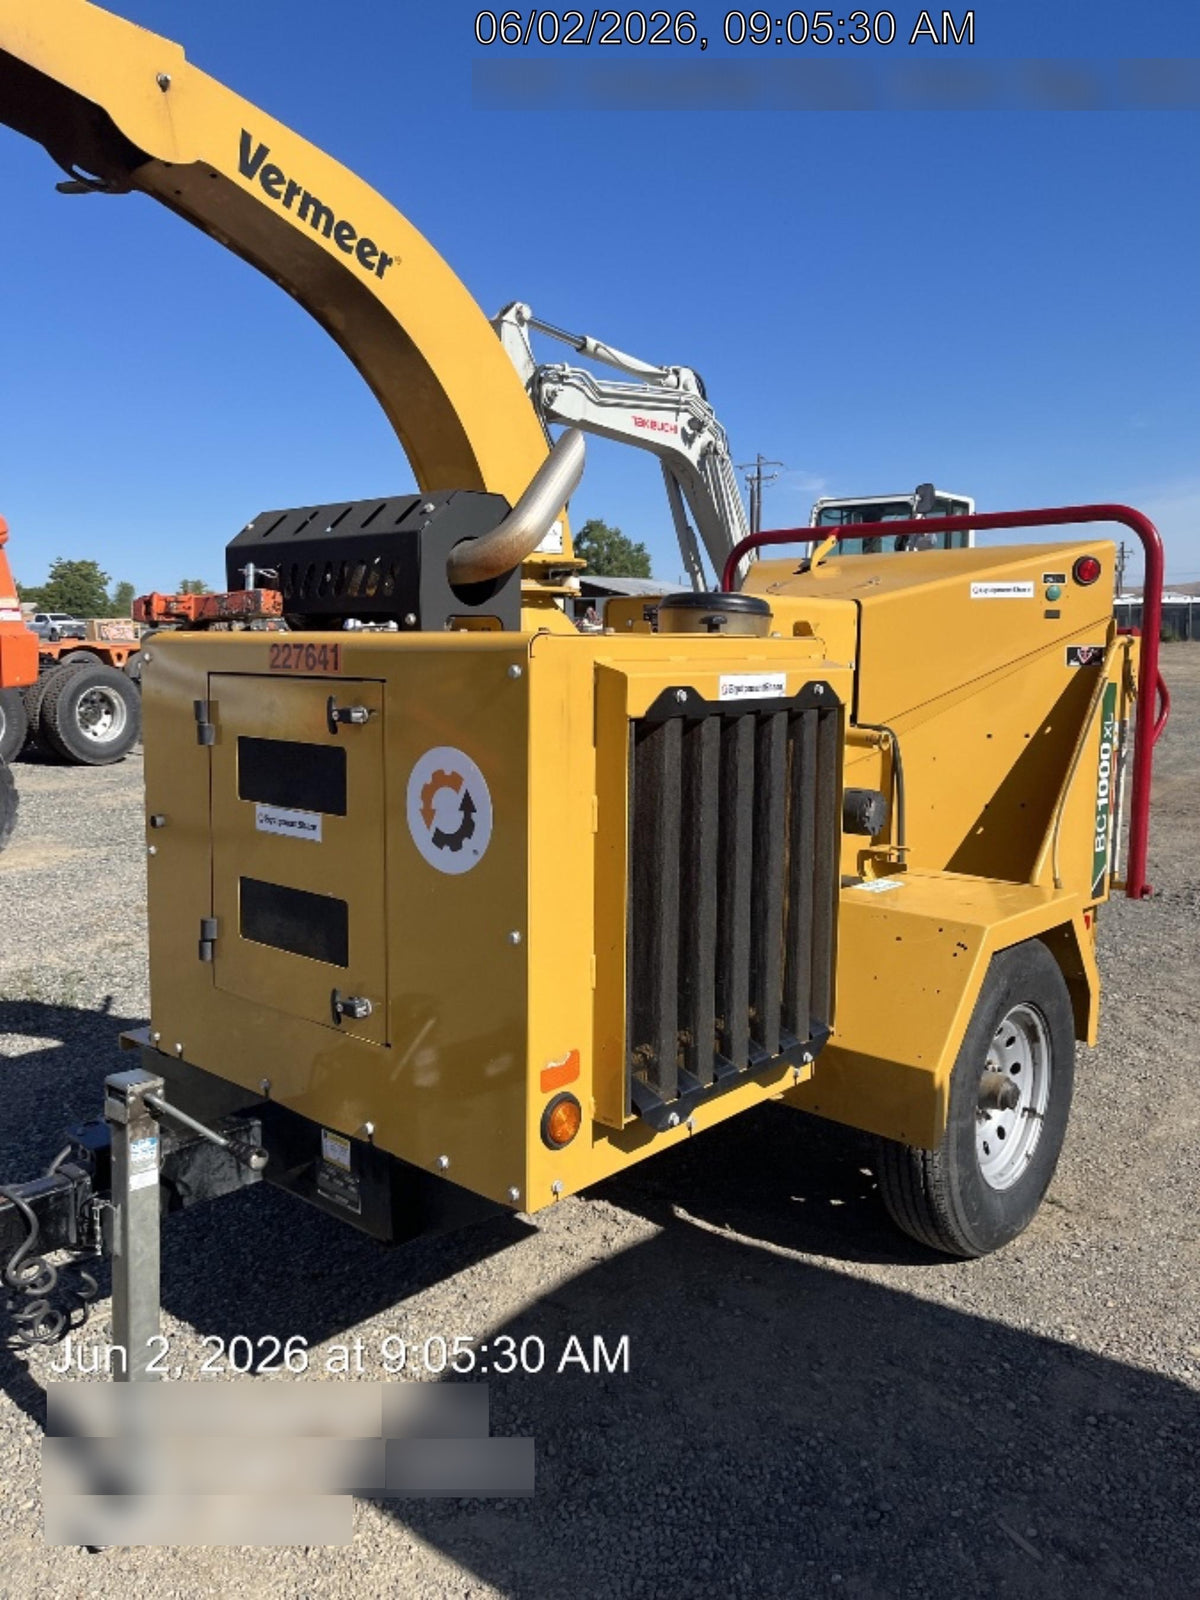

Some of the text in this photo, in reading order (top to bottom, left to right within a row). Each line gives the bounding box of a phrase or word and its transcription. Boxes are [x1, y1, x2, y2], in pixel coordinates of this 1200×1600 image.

[238, 127, 394, 280] Vermeer
[269, 643, 339, 671] 227641
[1103, 712, 1114, 739] XL
